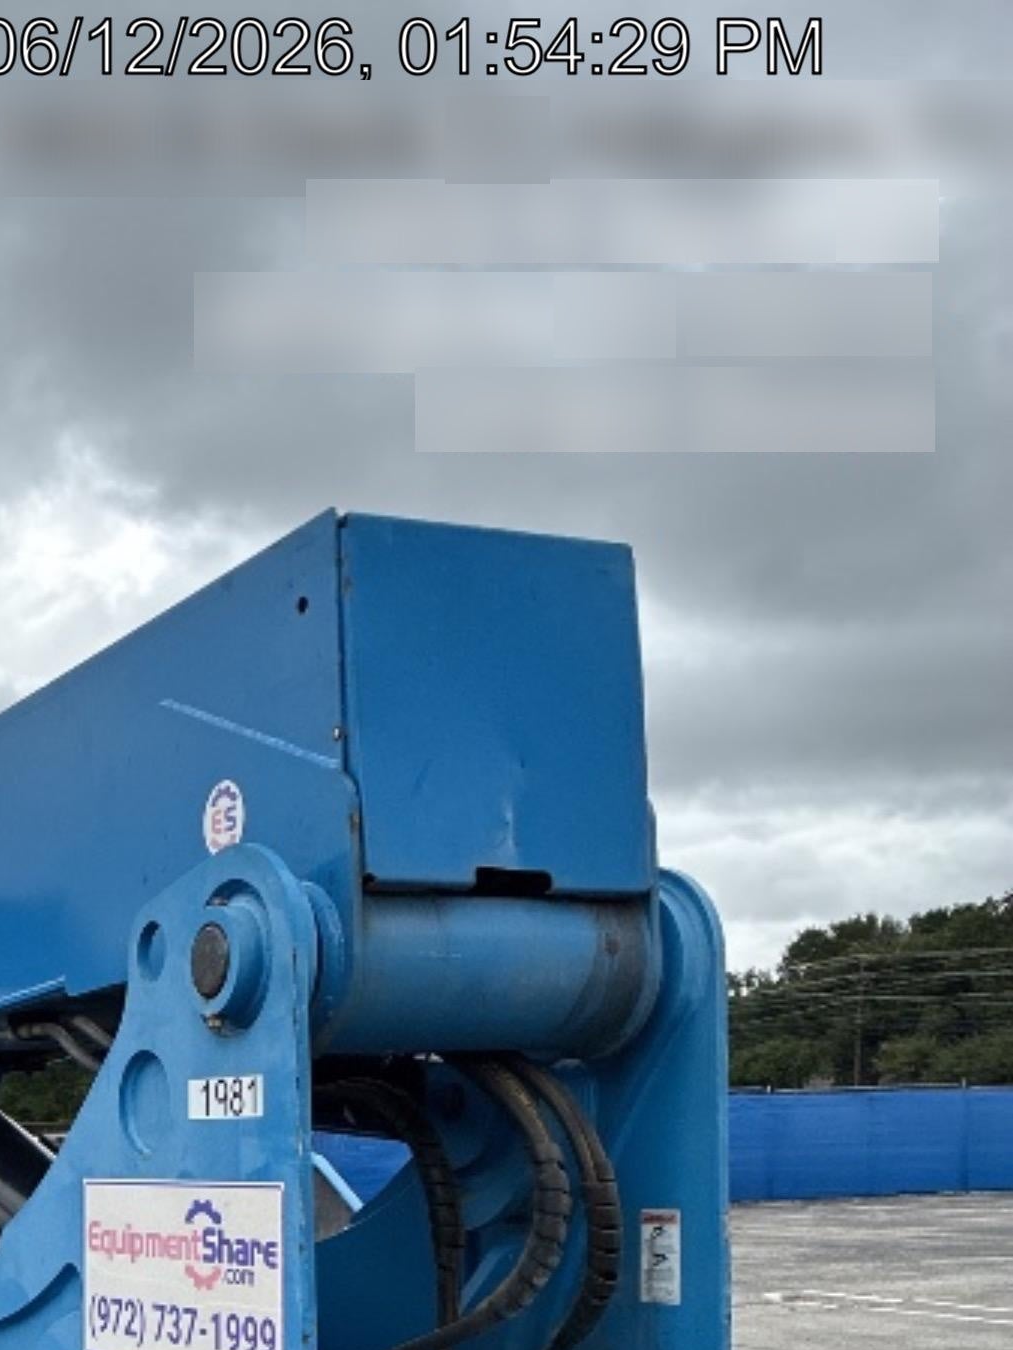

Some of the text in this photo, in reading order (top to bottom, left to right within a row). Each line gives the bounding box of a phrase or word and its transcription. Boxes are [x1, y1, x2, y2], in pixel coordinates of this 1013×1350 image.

[210, 804, 238, 835] ES
[201, 1076, 258, 1117] 1981
[88, 1220, 278, 1270] EquipmentShare
[89, 1293, 146, 1348] (972)
